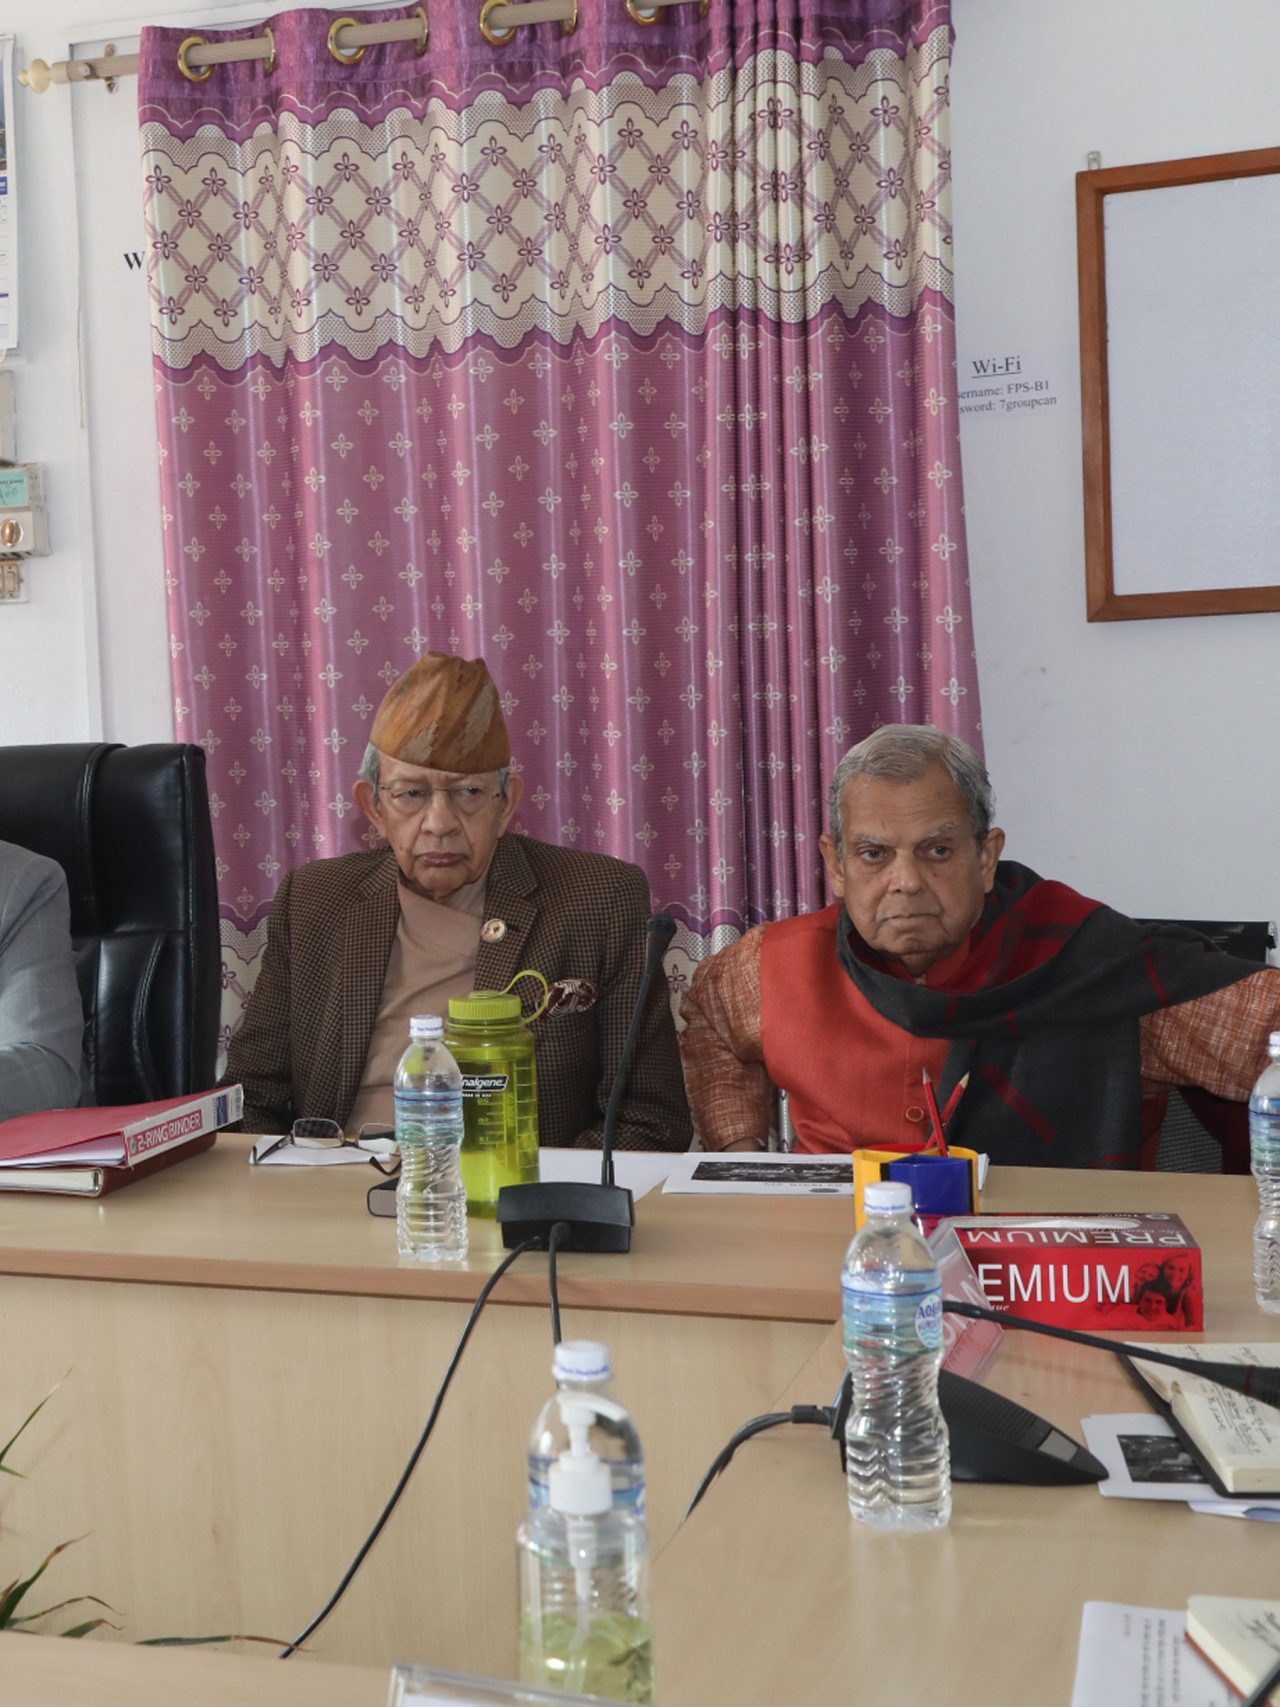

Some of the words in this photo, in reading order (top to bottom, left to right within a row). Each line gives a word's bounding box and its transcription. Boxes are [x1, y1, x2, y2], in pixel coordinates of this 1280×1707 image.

[972, 355, 1022, 376] Wi-Fi
[1007, 380, 1049, 394] FPS-B1
[1000, 396, 1057, 412] 7groupcan
[462, 1078, 503, 1089] nalgene
[136, 1123, 169, 1151] 2-RING
[169, 1112, 201, 1137] BINDER
[966, 1230, 1186, 1247] PREMIUM
[977, 1263, 1131, 1304] EMIUM
